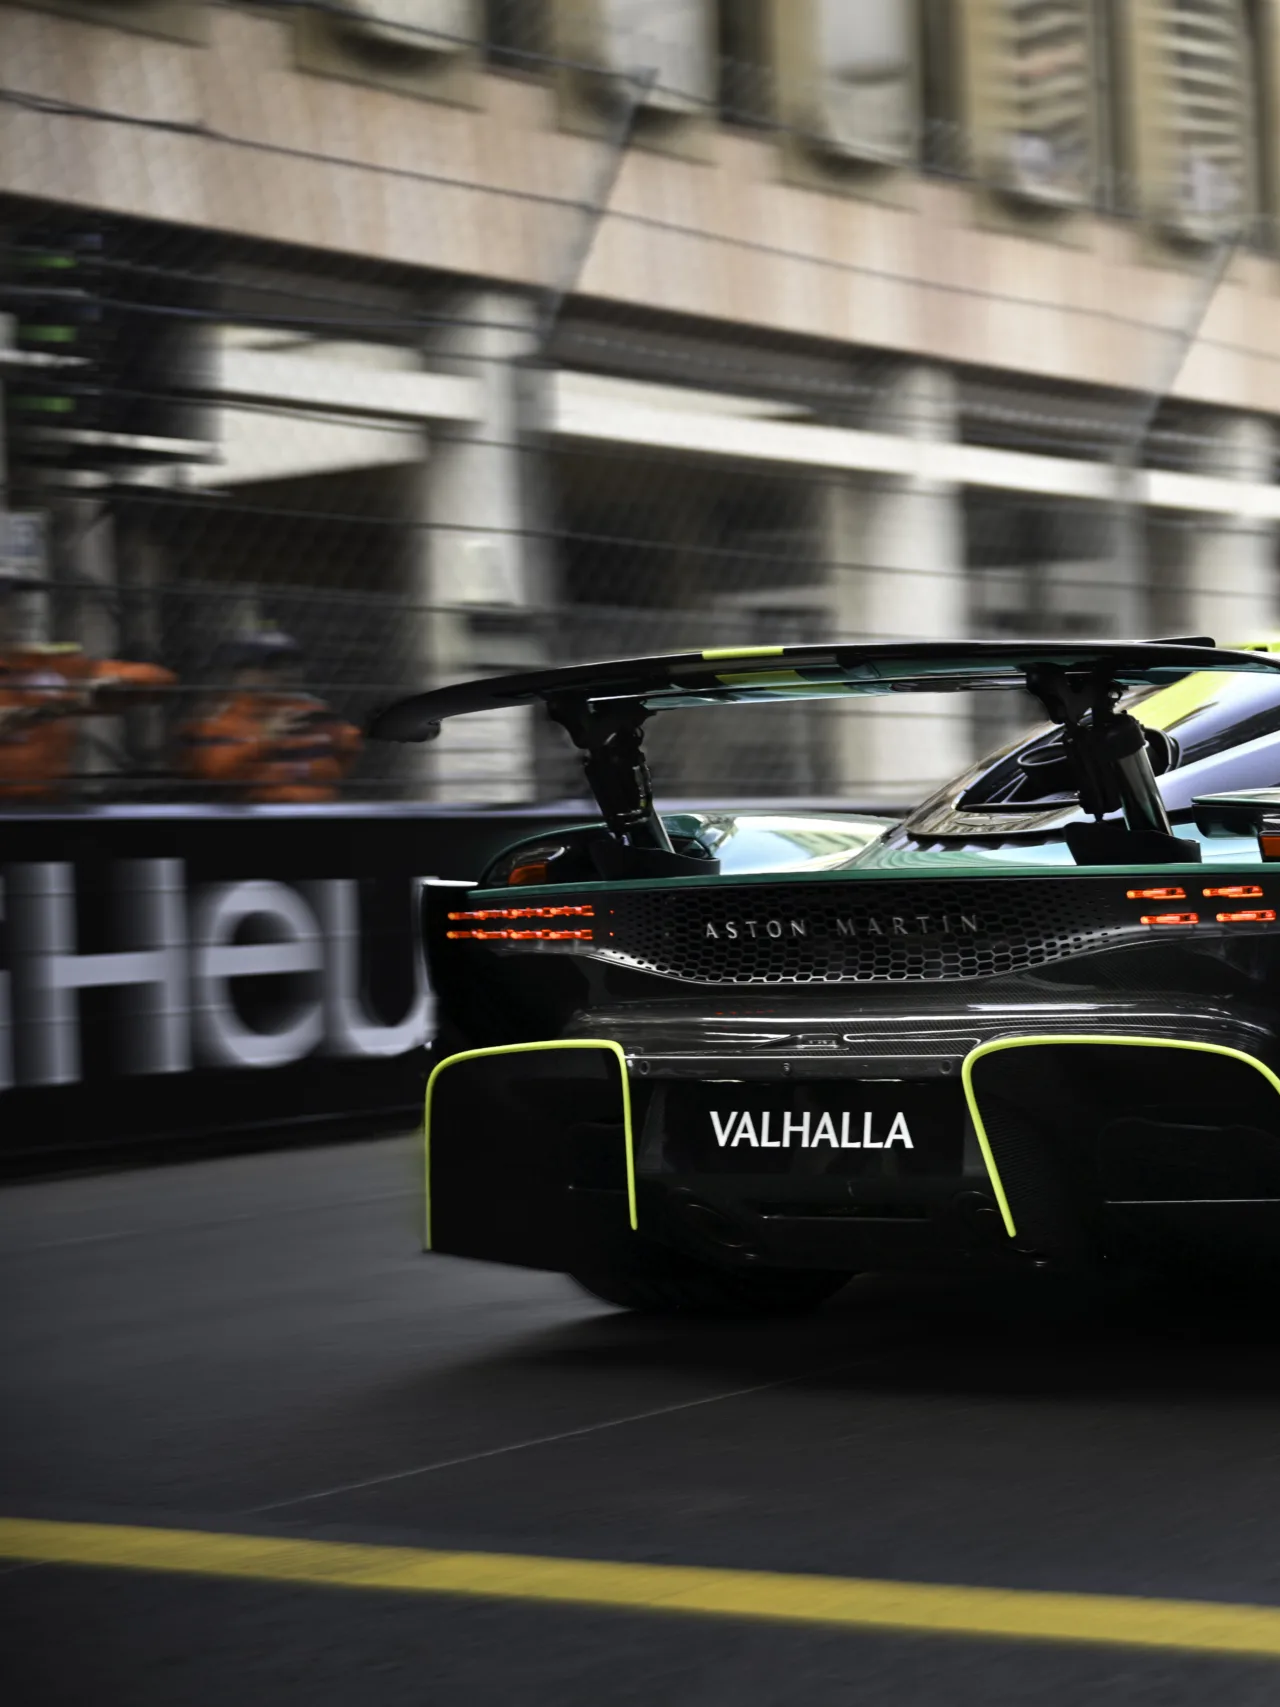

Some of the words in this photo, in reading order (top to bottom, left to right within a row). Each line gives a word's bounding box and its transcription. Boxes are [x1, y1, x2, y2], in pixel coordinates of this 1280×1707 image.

[705, 919, 807, 940] ASTON
[835, 914, 978, 936] MARTIN
[0, 857, 436, 1090] Heu
[709, 1111, 914, 1149] VALHALLA
